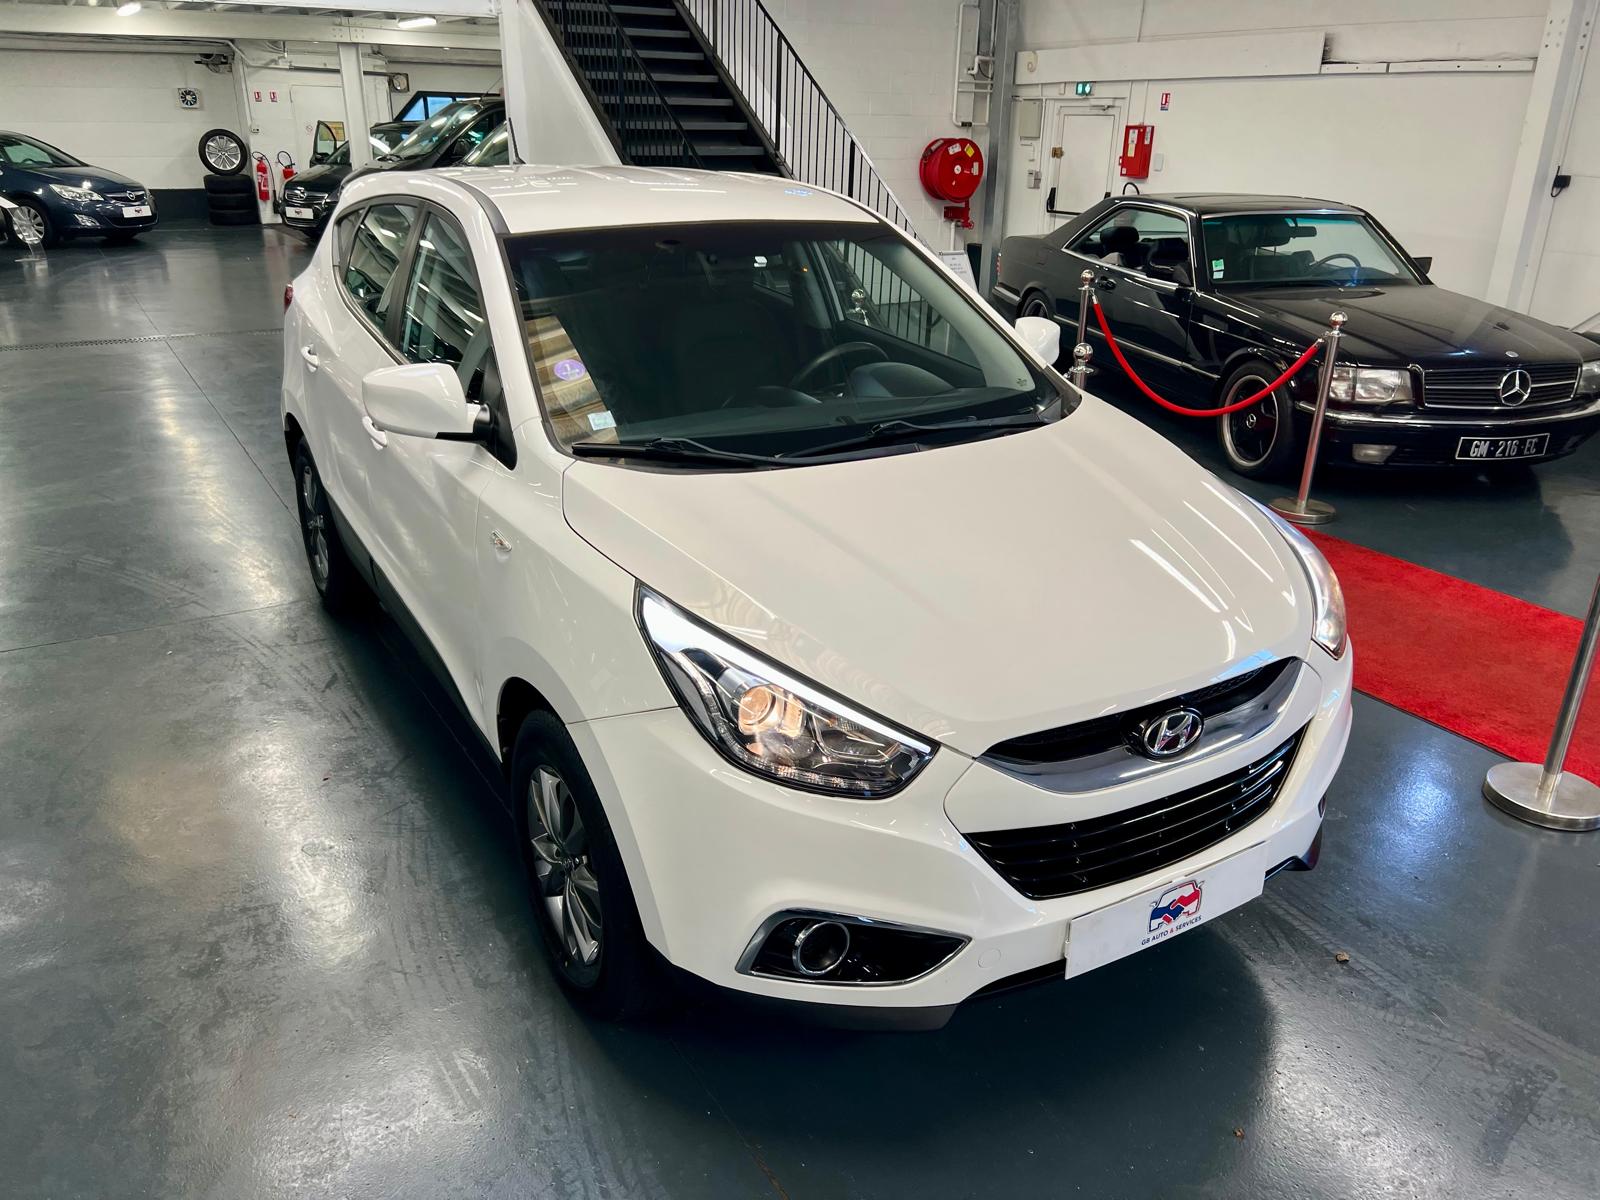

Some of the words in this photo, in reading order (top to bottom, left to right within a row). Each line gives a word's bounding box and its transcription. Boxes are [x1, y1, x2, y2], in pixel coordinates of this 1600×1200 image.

[1470, 441, 1490, 457] GM
[1495, 440, 1519, 457] 216
[1524, 438, 1538, 454] EC
[1152, 930, 1168, 940] AUTO
[1176, 915, 1201, 931] SERVICES
